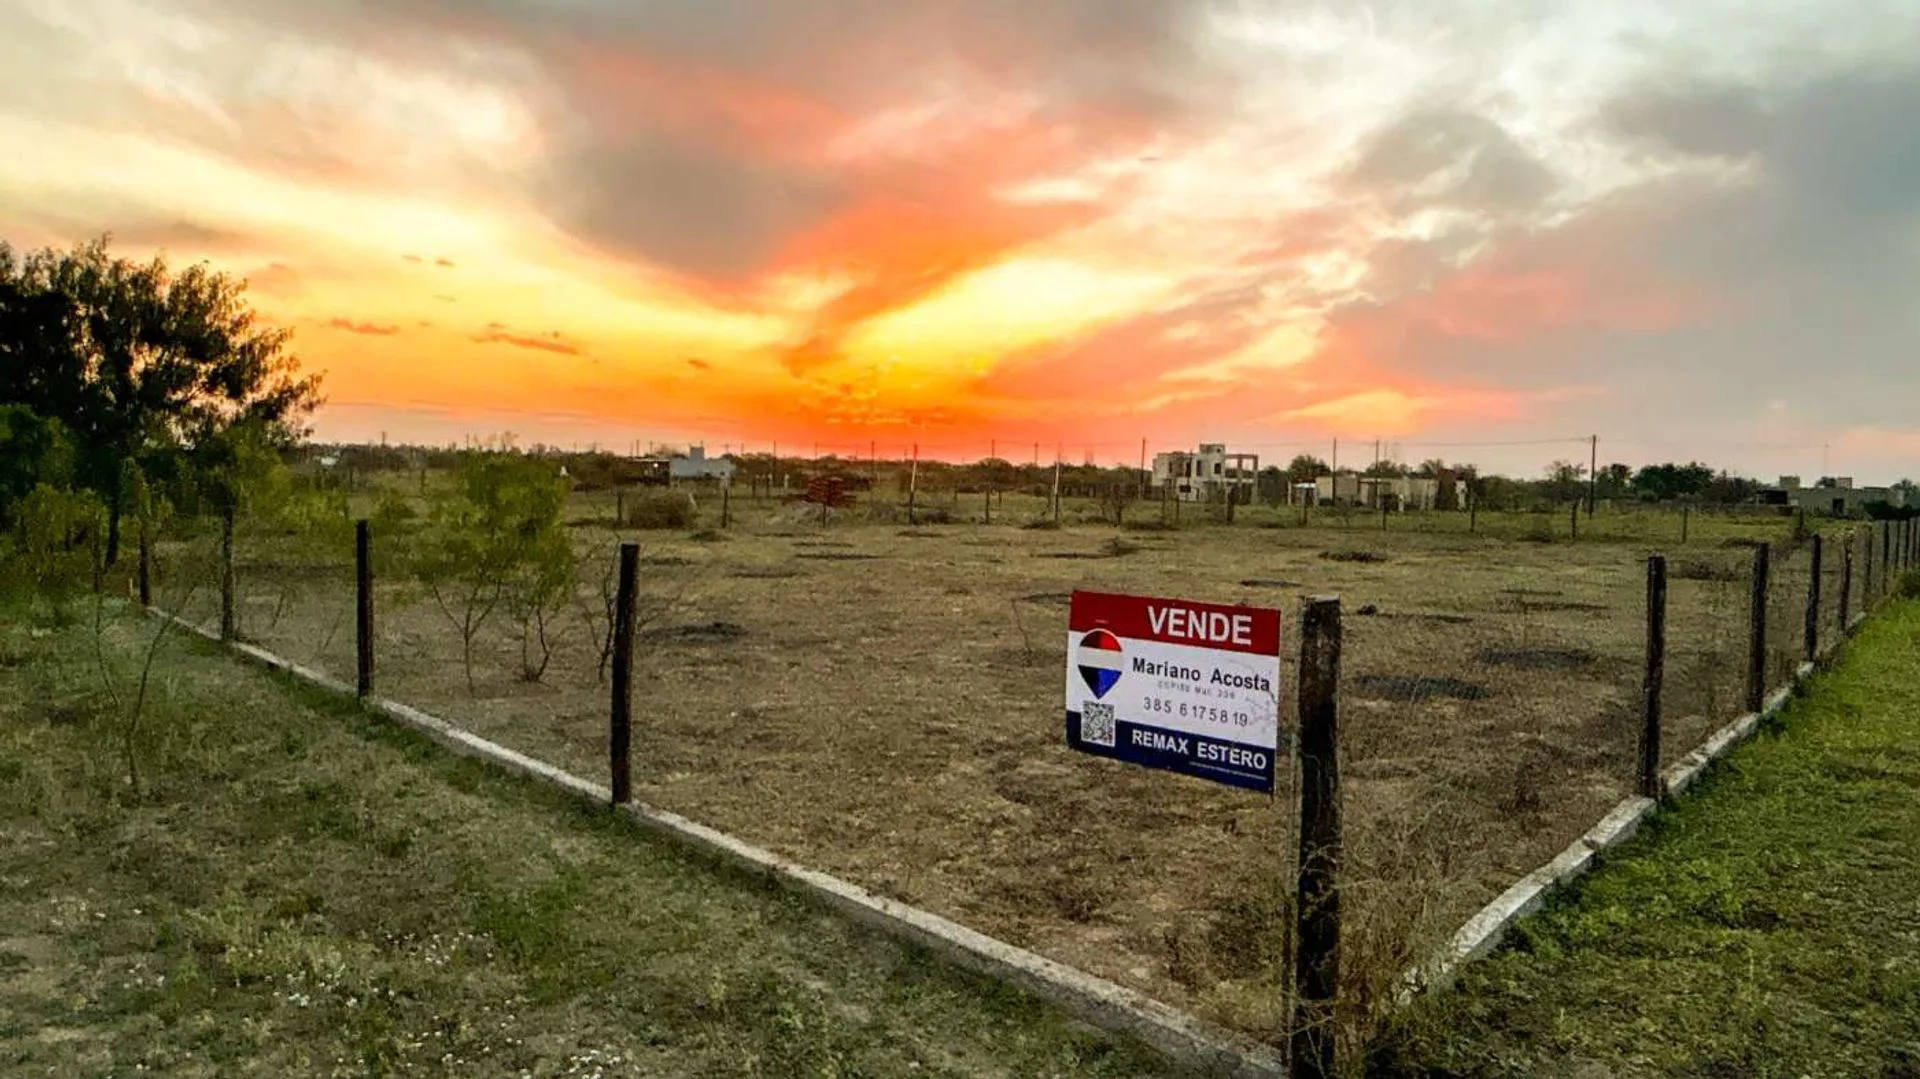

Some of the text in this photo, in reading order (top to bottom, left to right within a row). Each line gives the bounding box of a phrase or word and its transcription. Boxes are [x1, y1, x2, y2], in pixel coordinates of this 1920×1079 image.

[1147, 605, 1252, 645] VENDE
[1132, 657, 1270, 692] Mariano Acosta
[1143, 696, 1172, 714] 385
[1131, 729, 1267, 769] REMAX ESTERO
